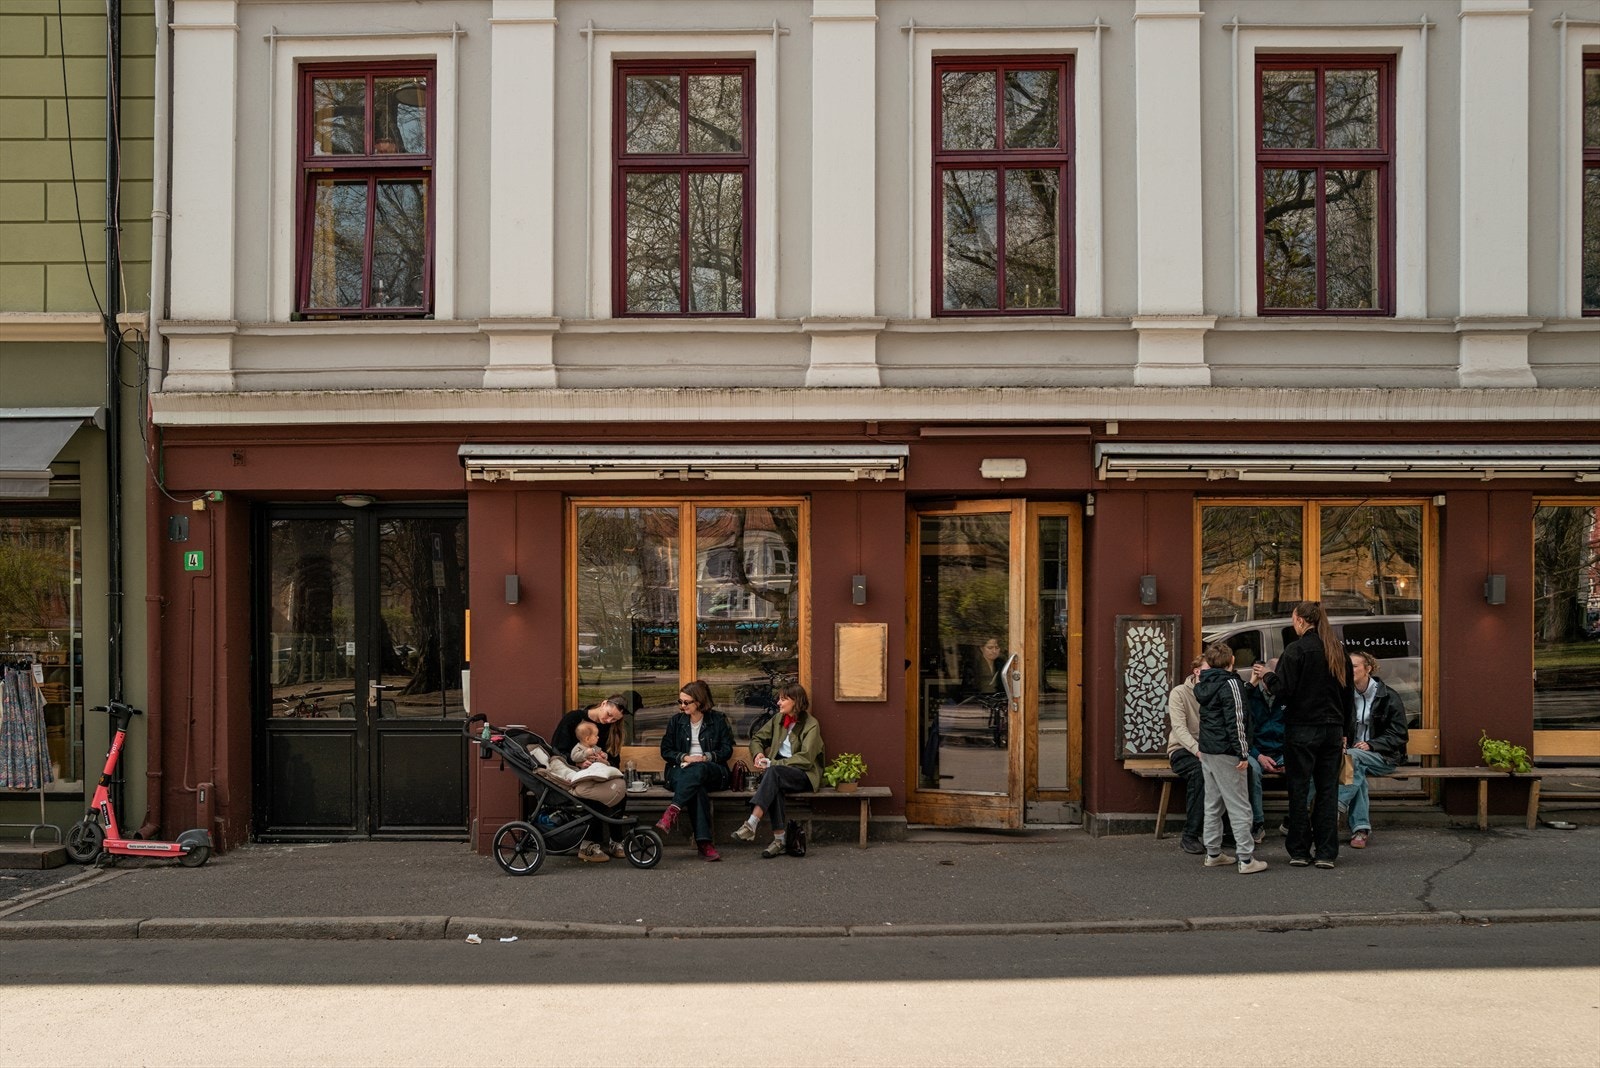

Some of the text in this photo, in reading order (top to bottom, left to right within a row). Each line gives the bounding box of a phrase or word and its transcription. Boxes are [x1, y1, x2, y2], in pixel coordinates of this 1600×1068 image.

[189, 554, 197, 567] 4
[1363, 638, 1411, 647] Collective
[709, 643, 788, 653] Babbo Collective
